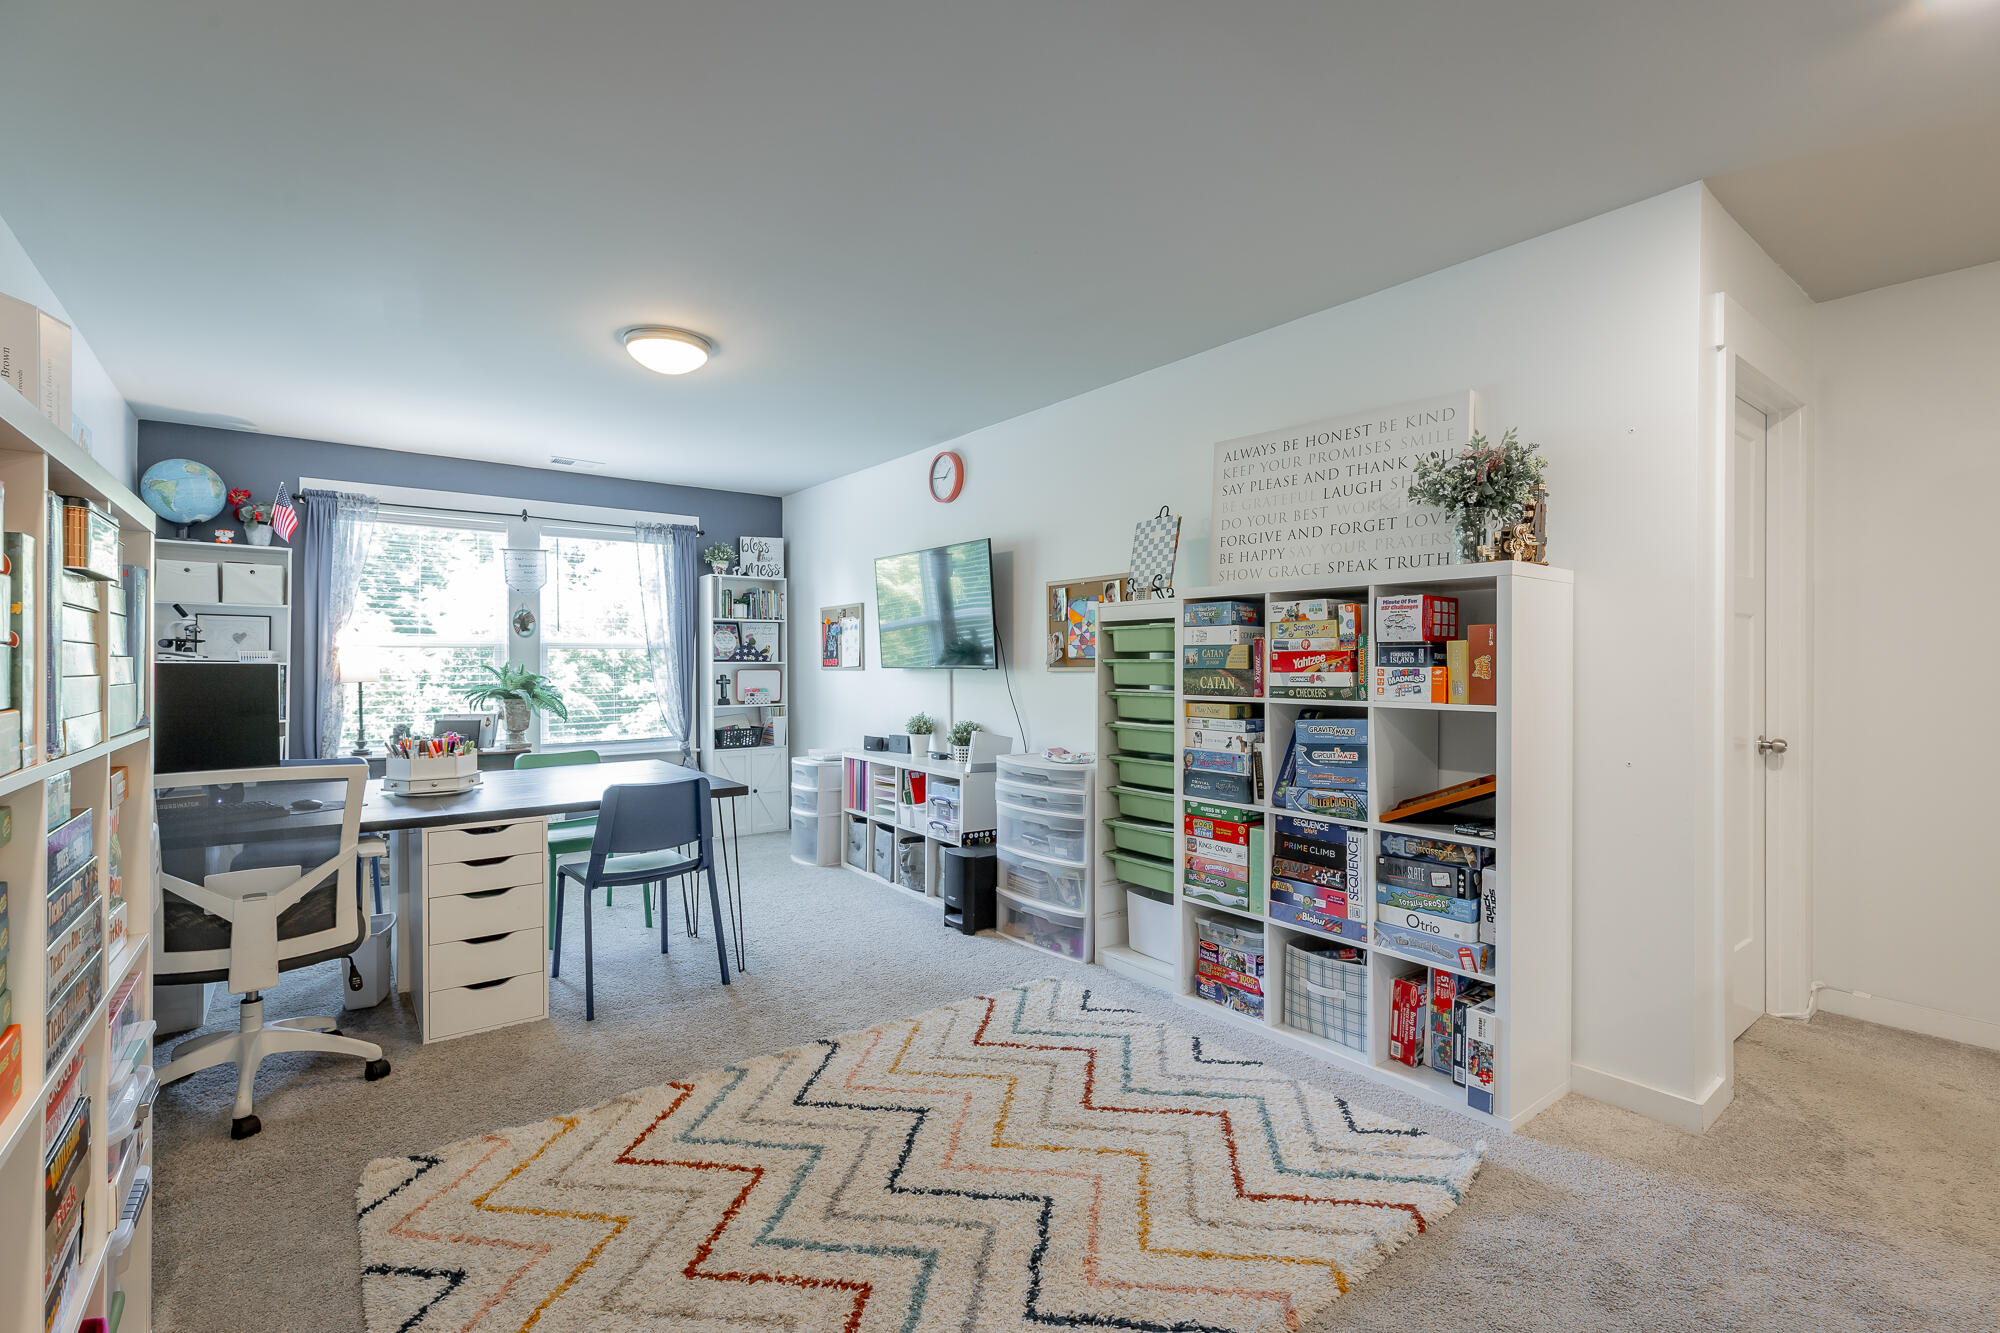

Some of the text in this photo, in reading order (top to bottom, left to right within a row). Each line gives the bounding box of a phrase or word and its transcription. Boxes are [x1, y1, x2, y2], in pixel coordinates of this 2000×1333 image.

[0, 346, 11, 378] Brown
[1224, 408, 1456, 463] ALWAYS BE HONEST BE KIND
[1223, 428, 1455, 480] KEEP YOUR PROMISES SMILE
[1222, 482, 1245, 497] SAY
[1251, 475, 1298, 492] PLEASE
[1304, 468, 1339, 484] AND
[1346, 456, 1408, 477] THANK
[1324, 480, 1382, 499] LAUGH
[1221, 518, 1242, 531] DO
[1247, 511, 1288, 527] YOUR
[1294, 507, 1328, 522] BEST
[1336, 499, 1392, 516] WORK
[1220, 530, 1282, 547] FORGIVE
[1288, 525, 1323, 540] AND
[1331, 517, 1398, 535] FORGET
[741, 538, 770, 554] bless
[1220, 553, 1235, 564] BE
[1240, 548, 1285, 562] HAPPY
[1321, 539, 1367, 556] YOUR
[1376, 531, 1450, 550] PRAYERS
[745, 563, 781, 577] mess
[1219, 552, 1450, 583] SHOW GRACE SPEAK TRUTH
[1202, 649, 1224, 657] CATAN
[1293, 654, 1326, 669] Yahtzee
[1200, 676, 1235, 689] CATAN
[1388, 675, 1425, 685] MADNESS
[1296, 688, 1326, 698] CHECKERS
[1293, 818, 1329, 831] SEQUENCE
[1284, 841, 1336, 858] PRIME CLIMB
[1348, 836, 1359, 901] SEQUENCE
[1408, 866, 1424, 881] SLATE
[48, 892, 67, 928] TICKET
[1302, 912, 1325, 925] Blokus
[1484, 894, 1494, 923] QUICK
[1406, 914, 1440, 934] Otrio
[50, 943, 67, 978] TICKET
[1441, 975, 1449, 987] 51
[47, 1000, 69, 1050] TICKET
[56, 1184, 76, 1235] Risk
